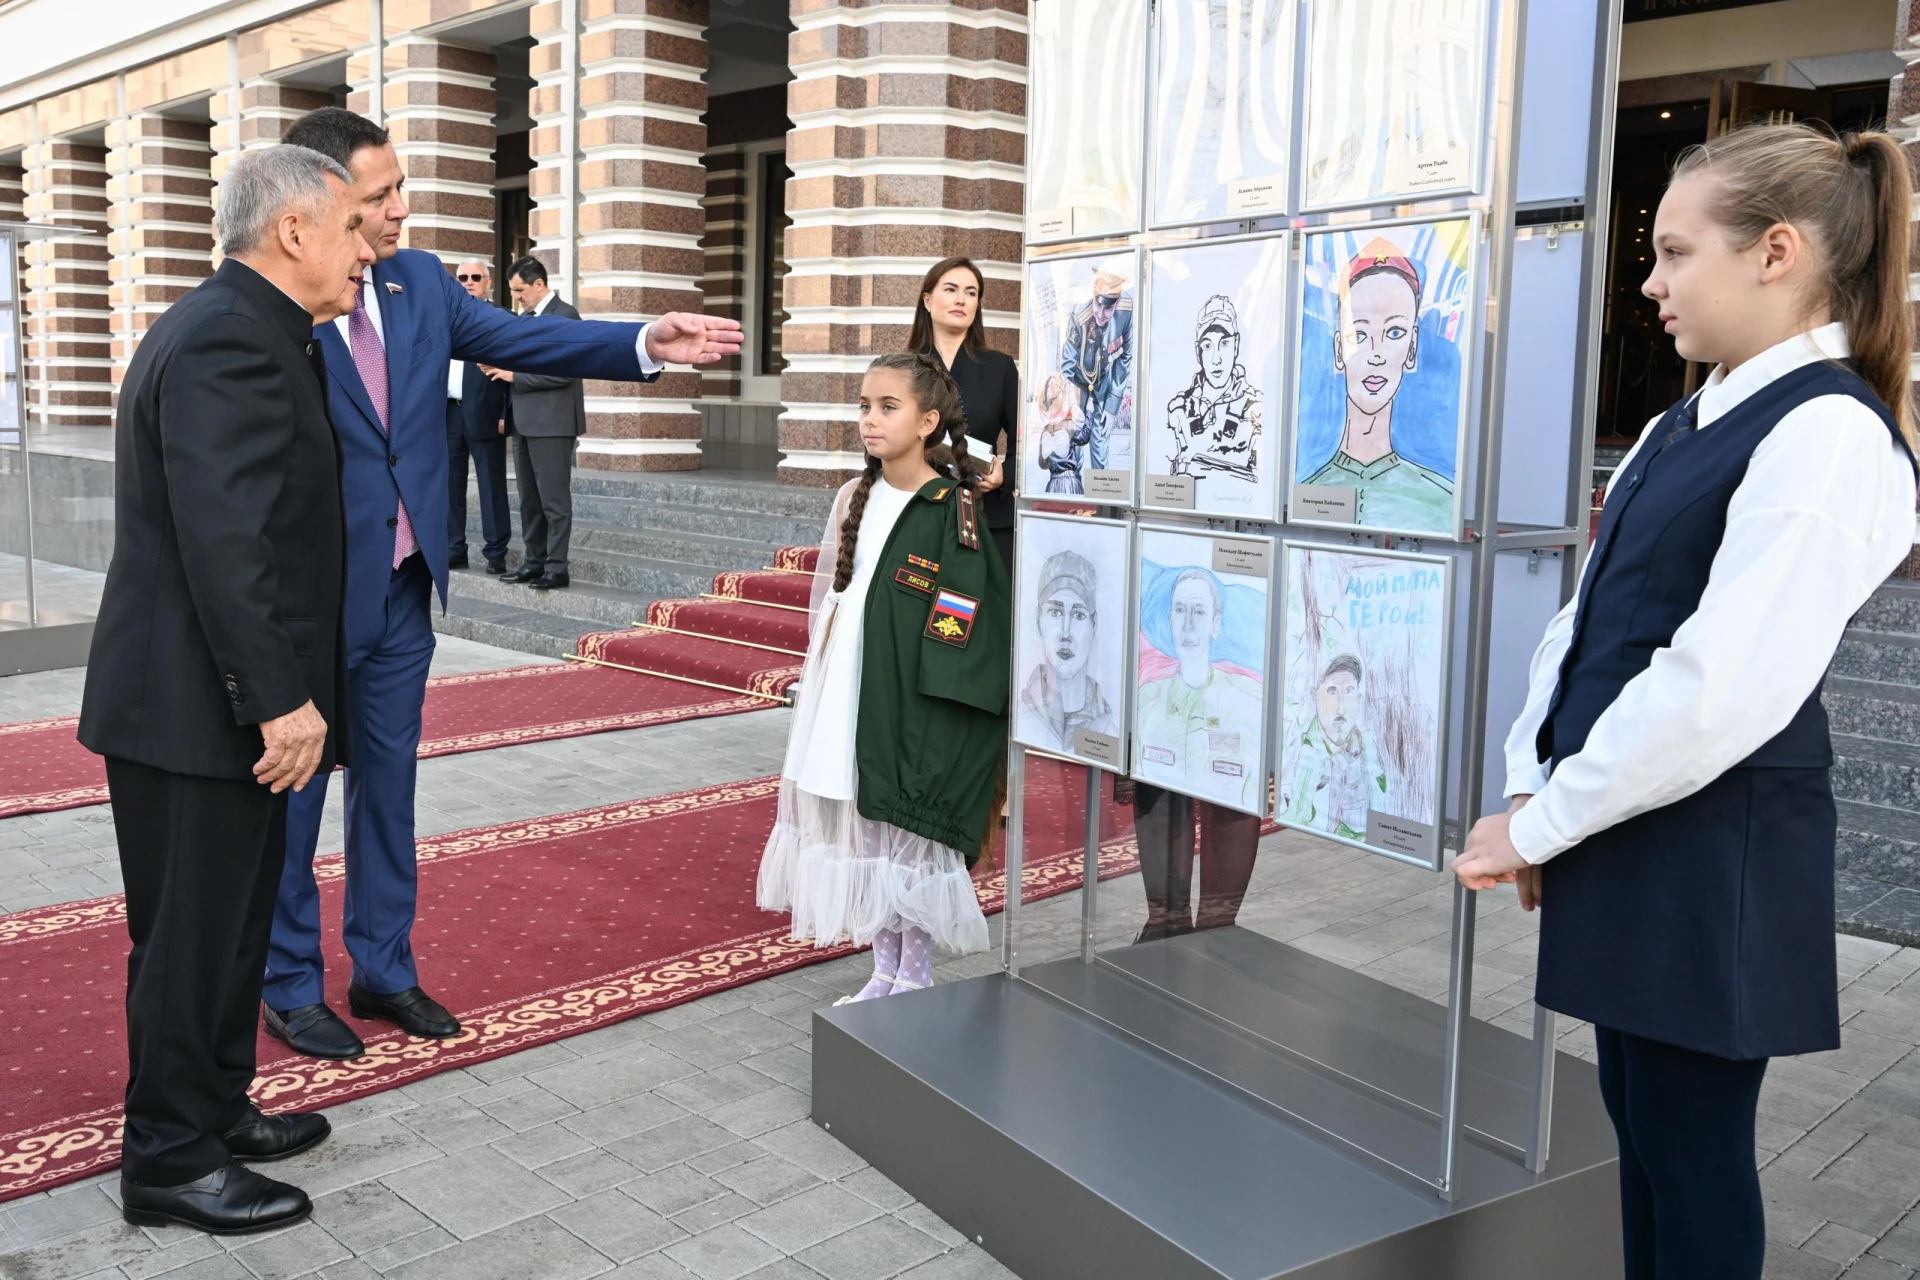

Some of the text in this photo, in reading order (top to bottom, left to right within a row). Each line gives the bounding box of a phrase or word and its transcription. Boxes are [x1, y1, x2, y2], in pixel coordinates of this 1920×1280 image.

[907, 575, 930, 588] ЛИСОВ
[1345, 570, 1440, 598] МОЙ ПАПА
